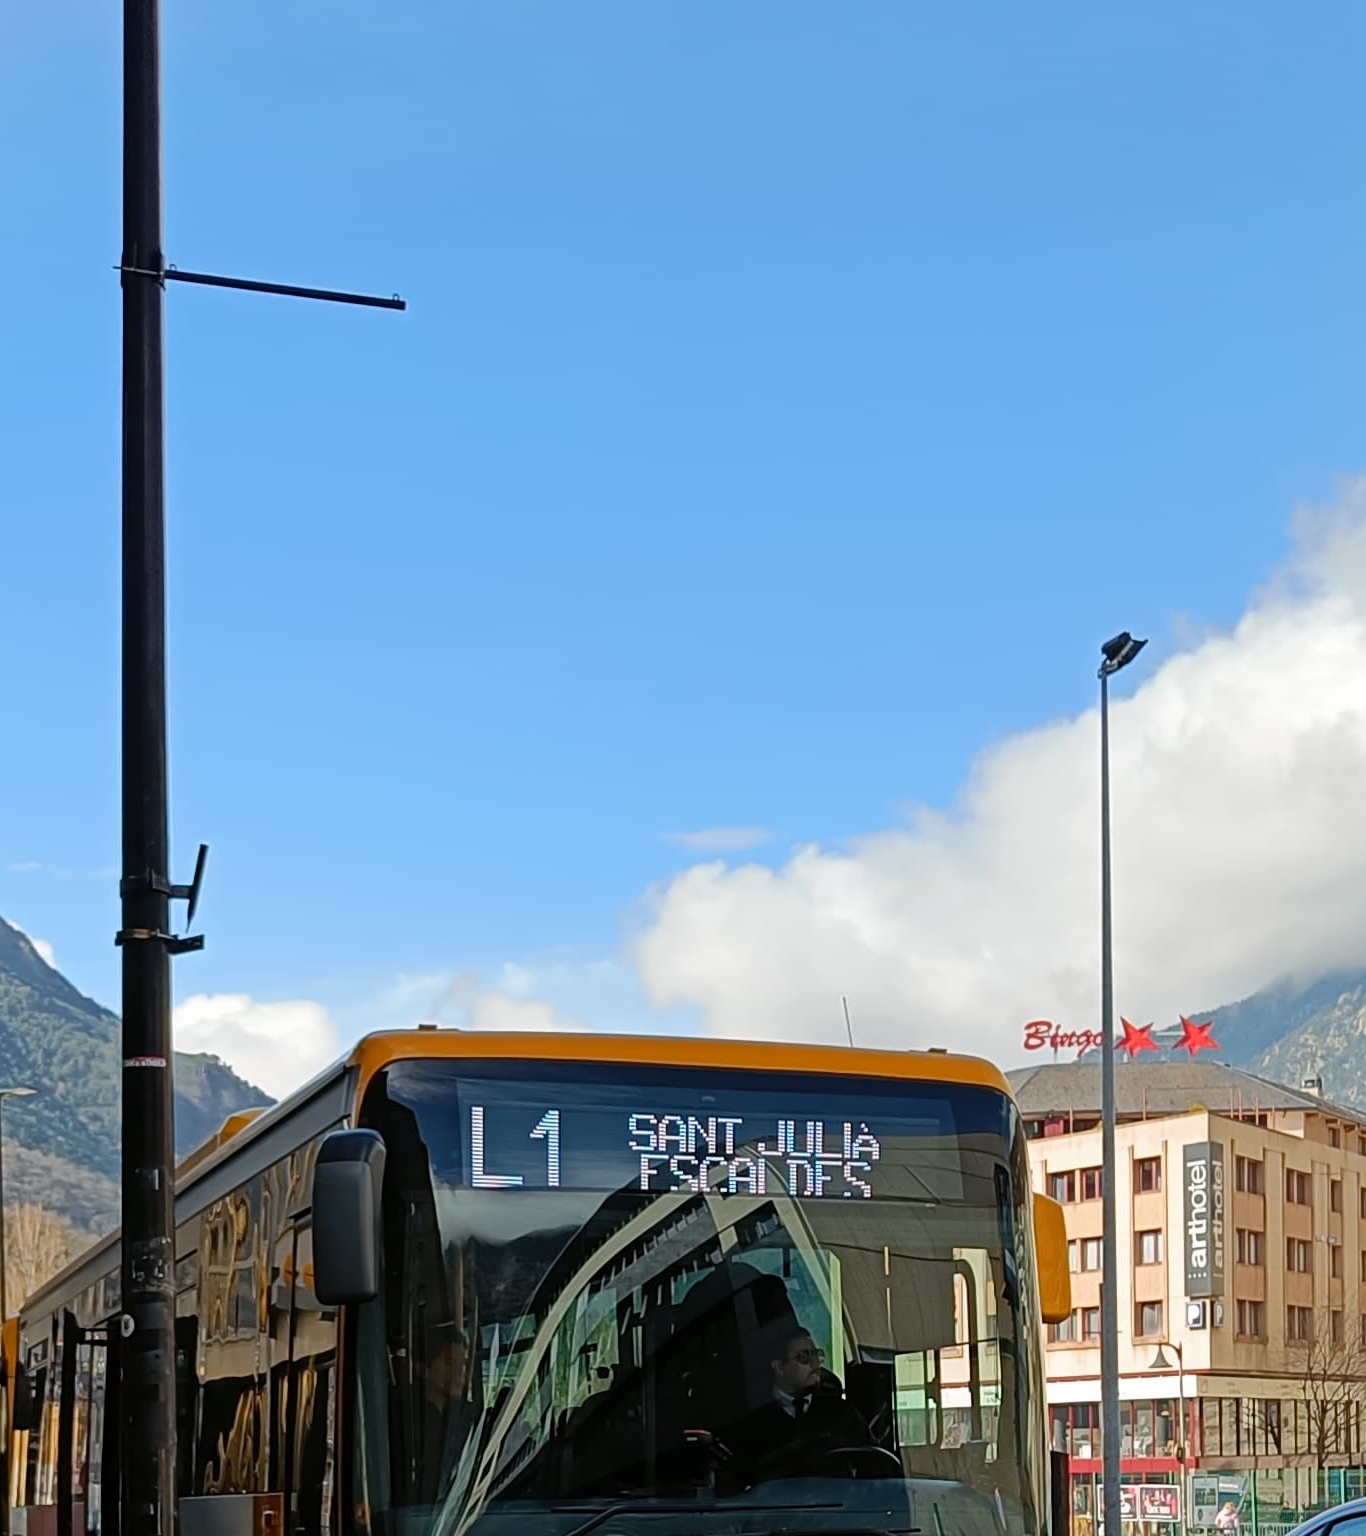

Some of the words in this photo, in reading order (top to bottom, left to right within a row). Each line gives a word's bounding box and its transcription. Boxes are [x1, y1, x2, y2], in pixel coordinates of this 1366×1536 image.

[1023, 1020, 1105, 1058] Bingo
[471, 1106, 560, 1188] L1
[629, 1113, 742, 1155] SANT
[1187, 1160, 1207, 1268] arthotel
[1212, 1161, 1223, 1267] arthotel
